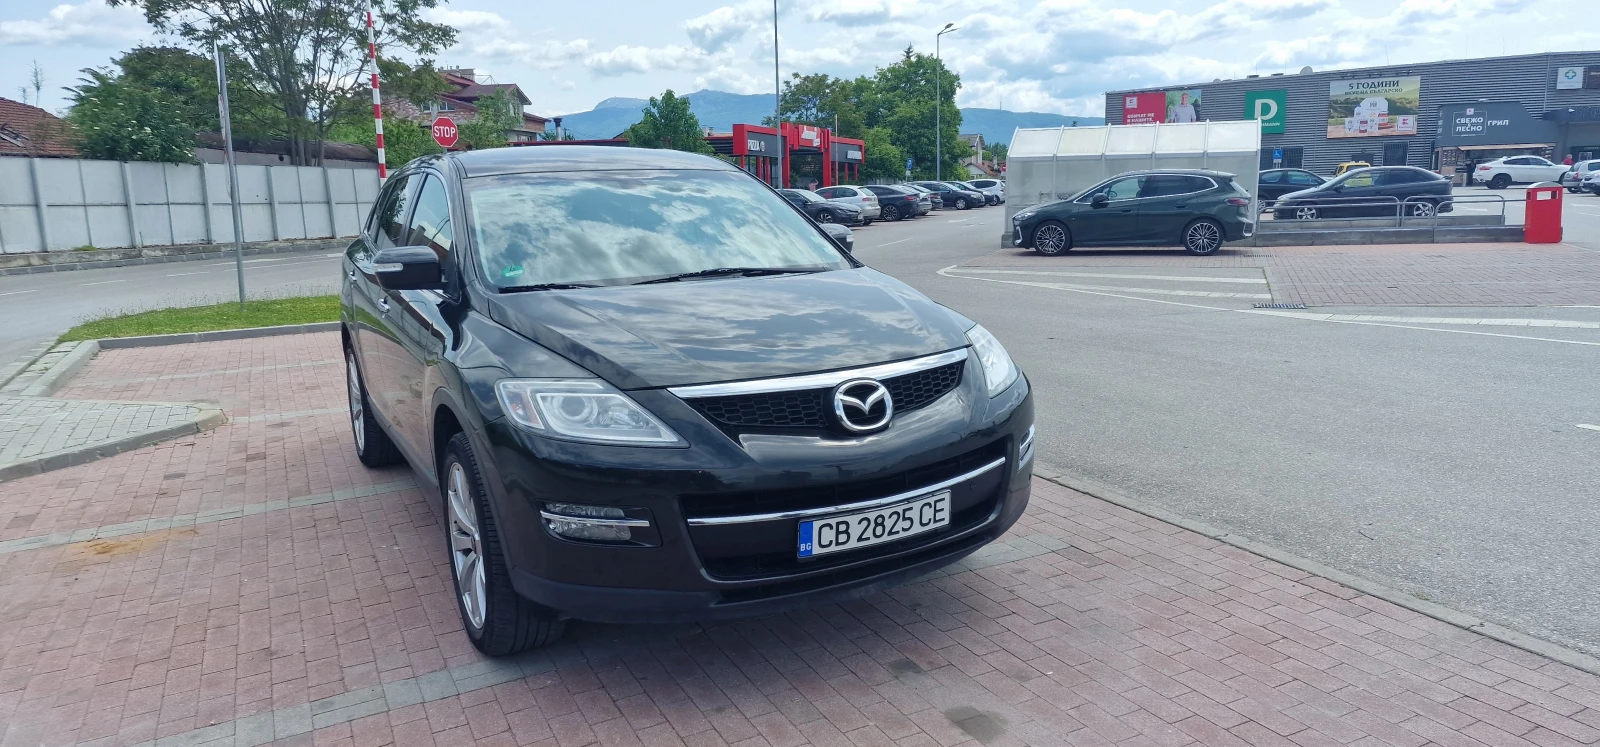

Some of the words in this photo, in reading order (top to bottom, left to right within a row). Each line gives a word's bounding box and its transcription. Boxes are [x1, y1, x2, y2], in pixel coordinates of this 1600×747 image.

[1356, 80, 1400, 89] ГОДИНИ
[1254, 98, 1278, 120] D
[434, 126, 456, 138] STOP
[748, 140, 760, 151] PIZZA
[817, 520, 851, 549] CB
[856, 506, 914, 543] 2825
[919, 497, 946, 527] CE
[800, 543, 812, 551] BG
